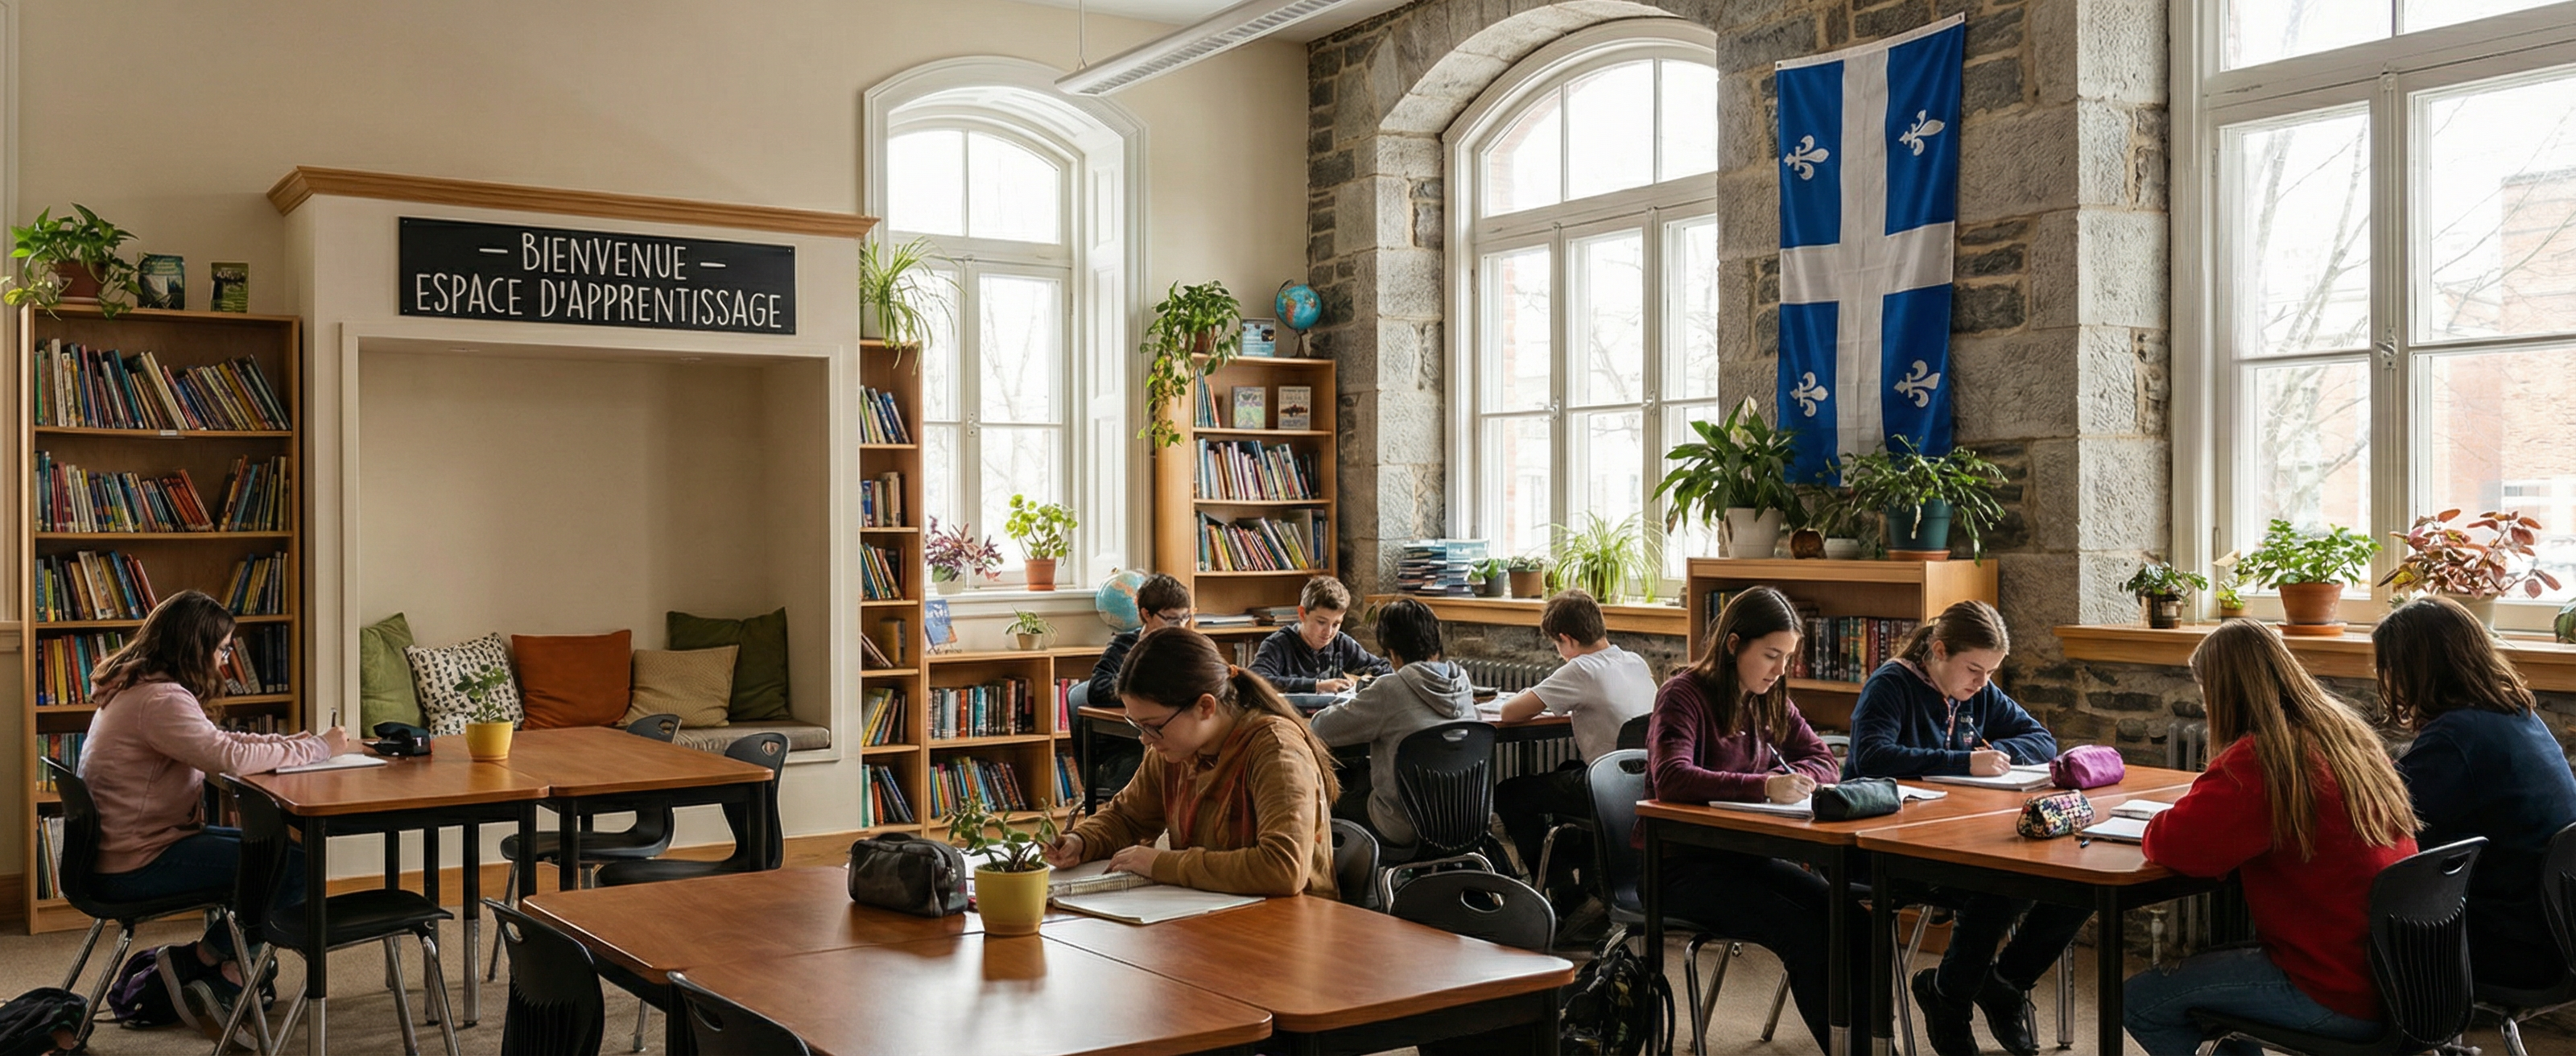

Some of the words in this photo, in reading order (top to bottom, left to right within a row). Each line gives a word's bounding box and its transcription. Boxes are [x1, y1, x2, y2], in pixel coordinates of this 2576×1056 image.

[522, 233, 687, 280] BIENVENUE
[416, 273, 522, 315] ESPACE
[540, 278, 782, 328] D'APPRENTISSAGE
